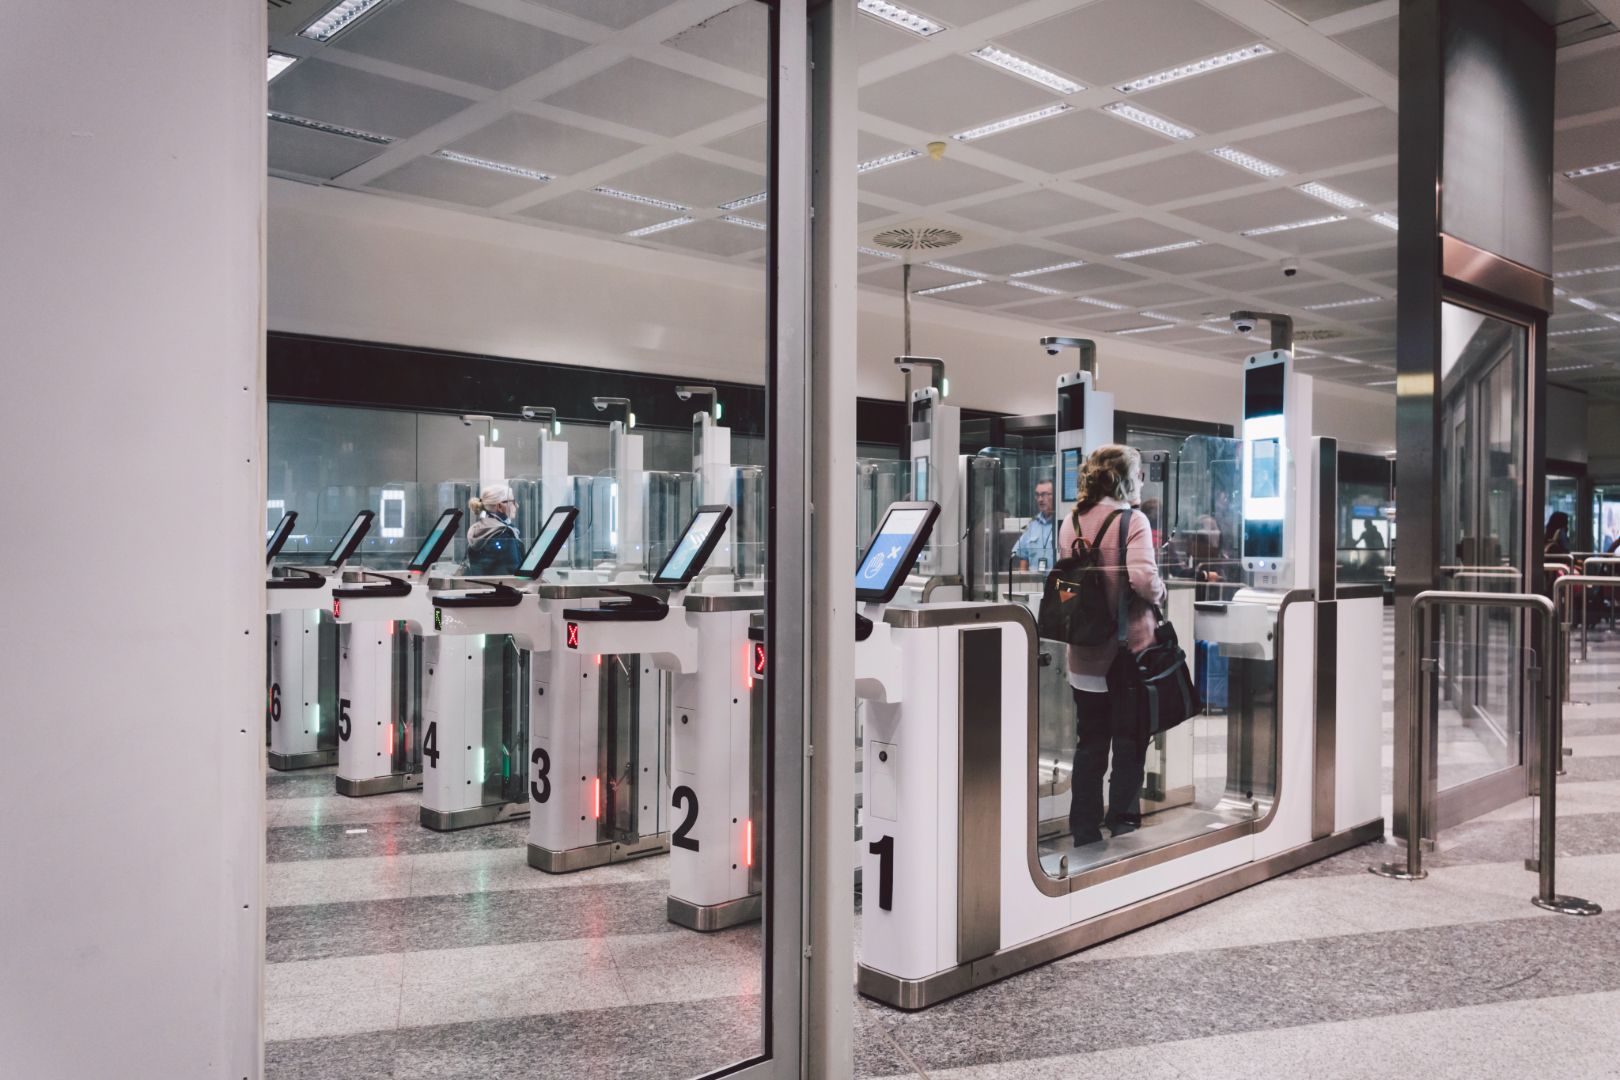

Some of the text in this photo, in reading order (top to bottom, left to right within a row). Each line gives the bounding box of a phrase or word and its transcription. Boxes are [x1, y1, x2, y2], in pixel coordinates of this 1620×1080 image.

[271, 683, 281, 721] 6
[338, 699, 351, 742] 5
[423, 721, 439, 768] 4
[531, 748, 552, 804] 3
[672, 785, 700, 852] 2
[869, 834, 894, 911] 1
